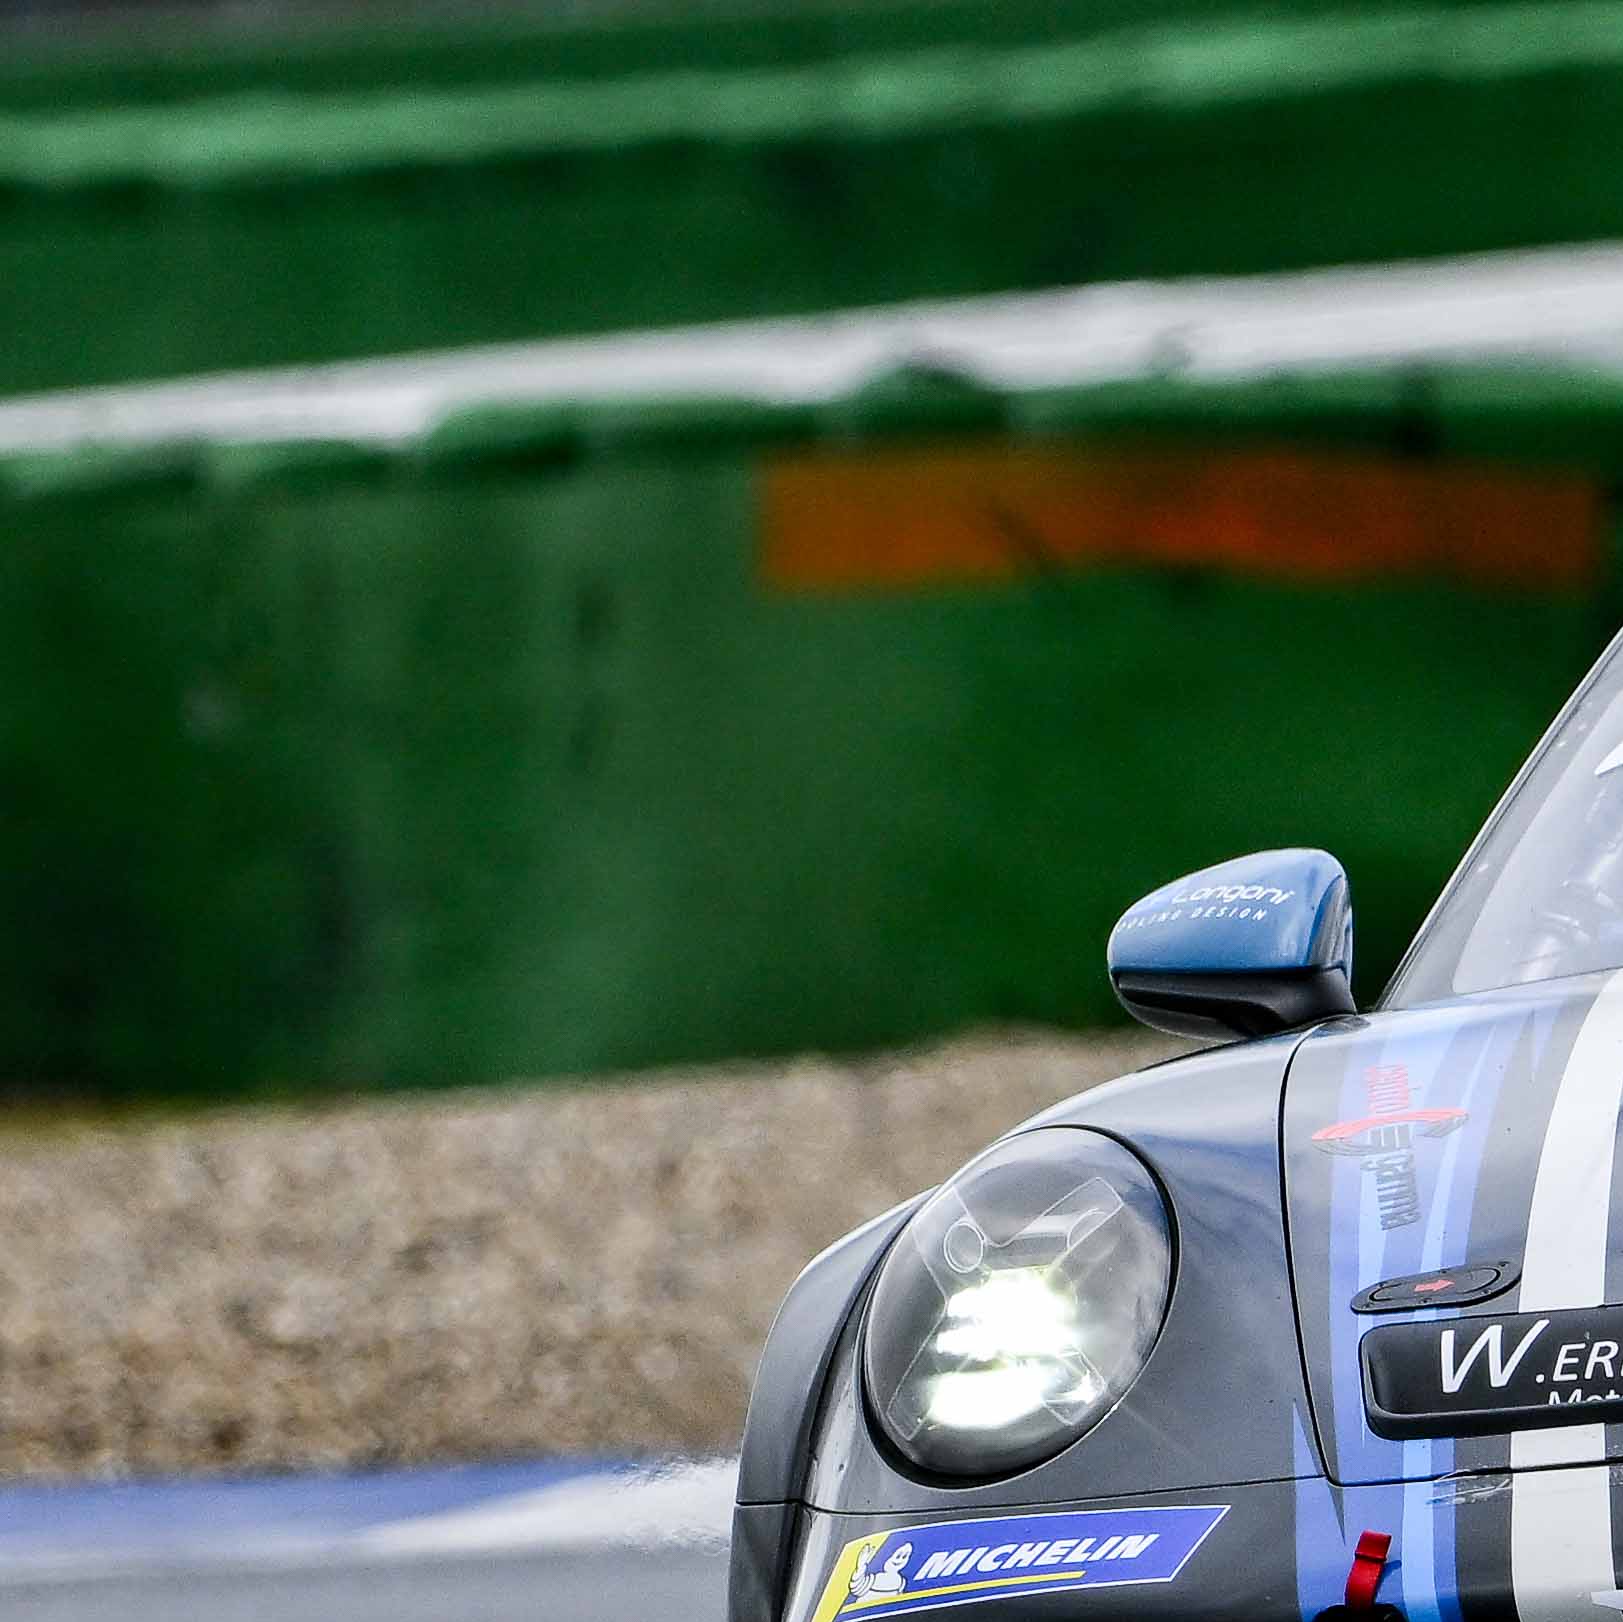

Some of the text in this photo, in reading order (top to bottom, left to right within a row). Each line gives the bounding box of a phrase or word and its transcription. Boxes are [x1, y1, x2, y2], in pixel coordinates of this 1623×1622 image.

[1172, 884, 1296, 905] Longoni
[1192, 906, 1268, 921] DESIGN
[913, 1532, 1160, 1581] MICHELIN
